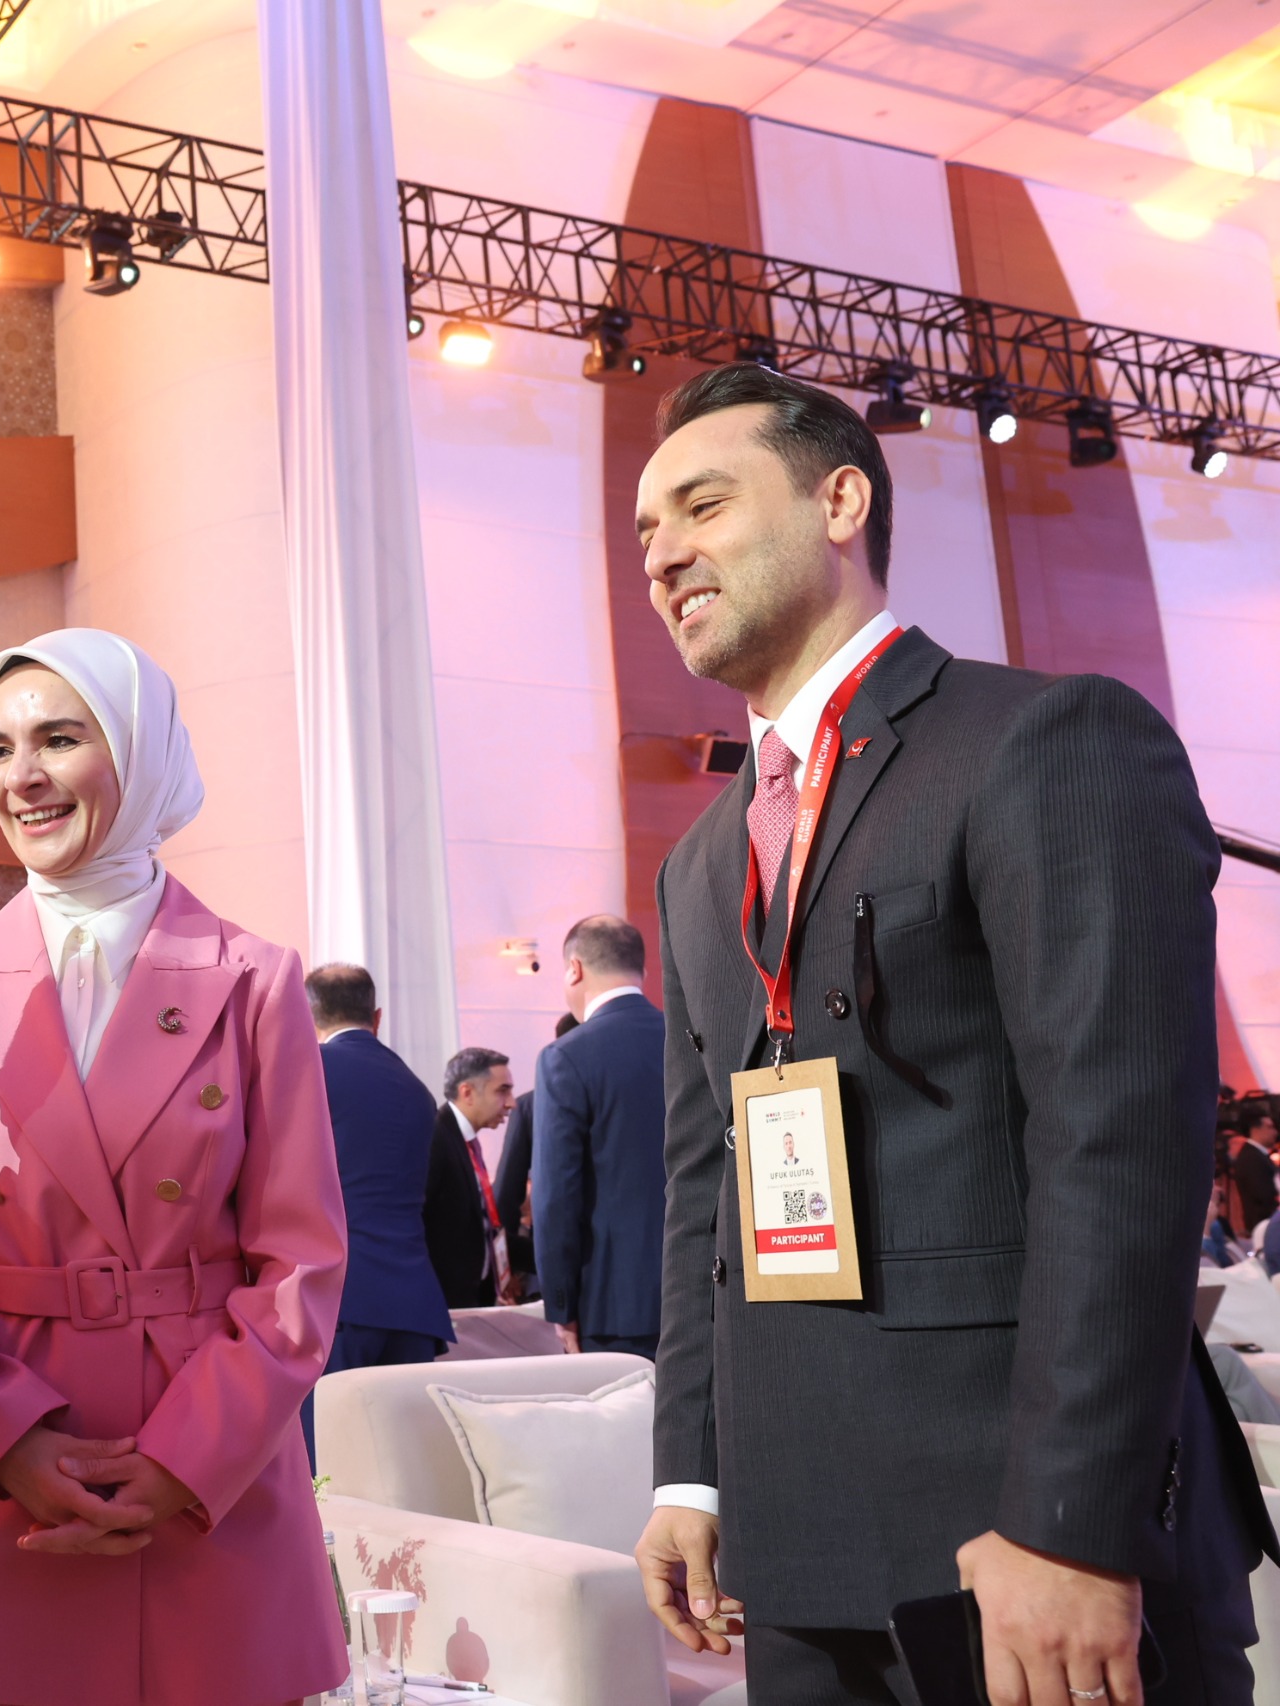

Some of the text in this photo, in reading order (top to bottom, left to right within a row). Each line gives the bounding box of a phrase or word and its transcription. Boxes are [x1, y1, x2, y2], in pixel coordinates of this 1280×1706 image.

[810, 726, 834, 788] PARTICIPANT
[797, 809, 808, 843] WORLD
[802, 809, 815, 843] SUMMIT
[770, 1171, 788, 1180] UFUK
[771, 1232, 825, 1246] PARTICIPANT
